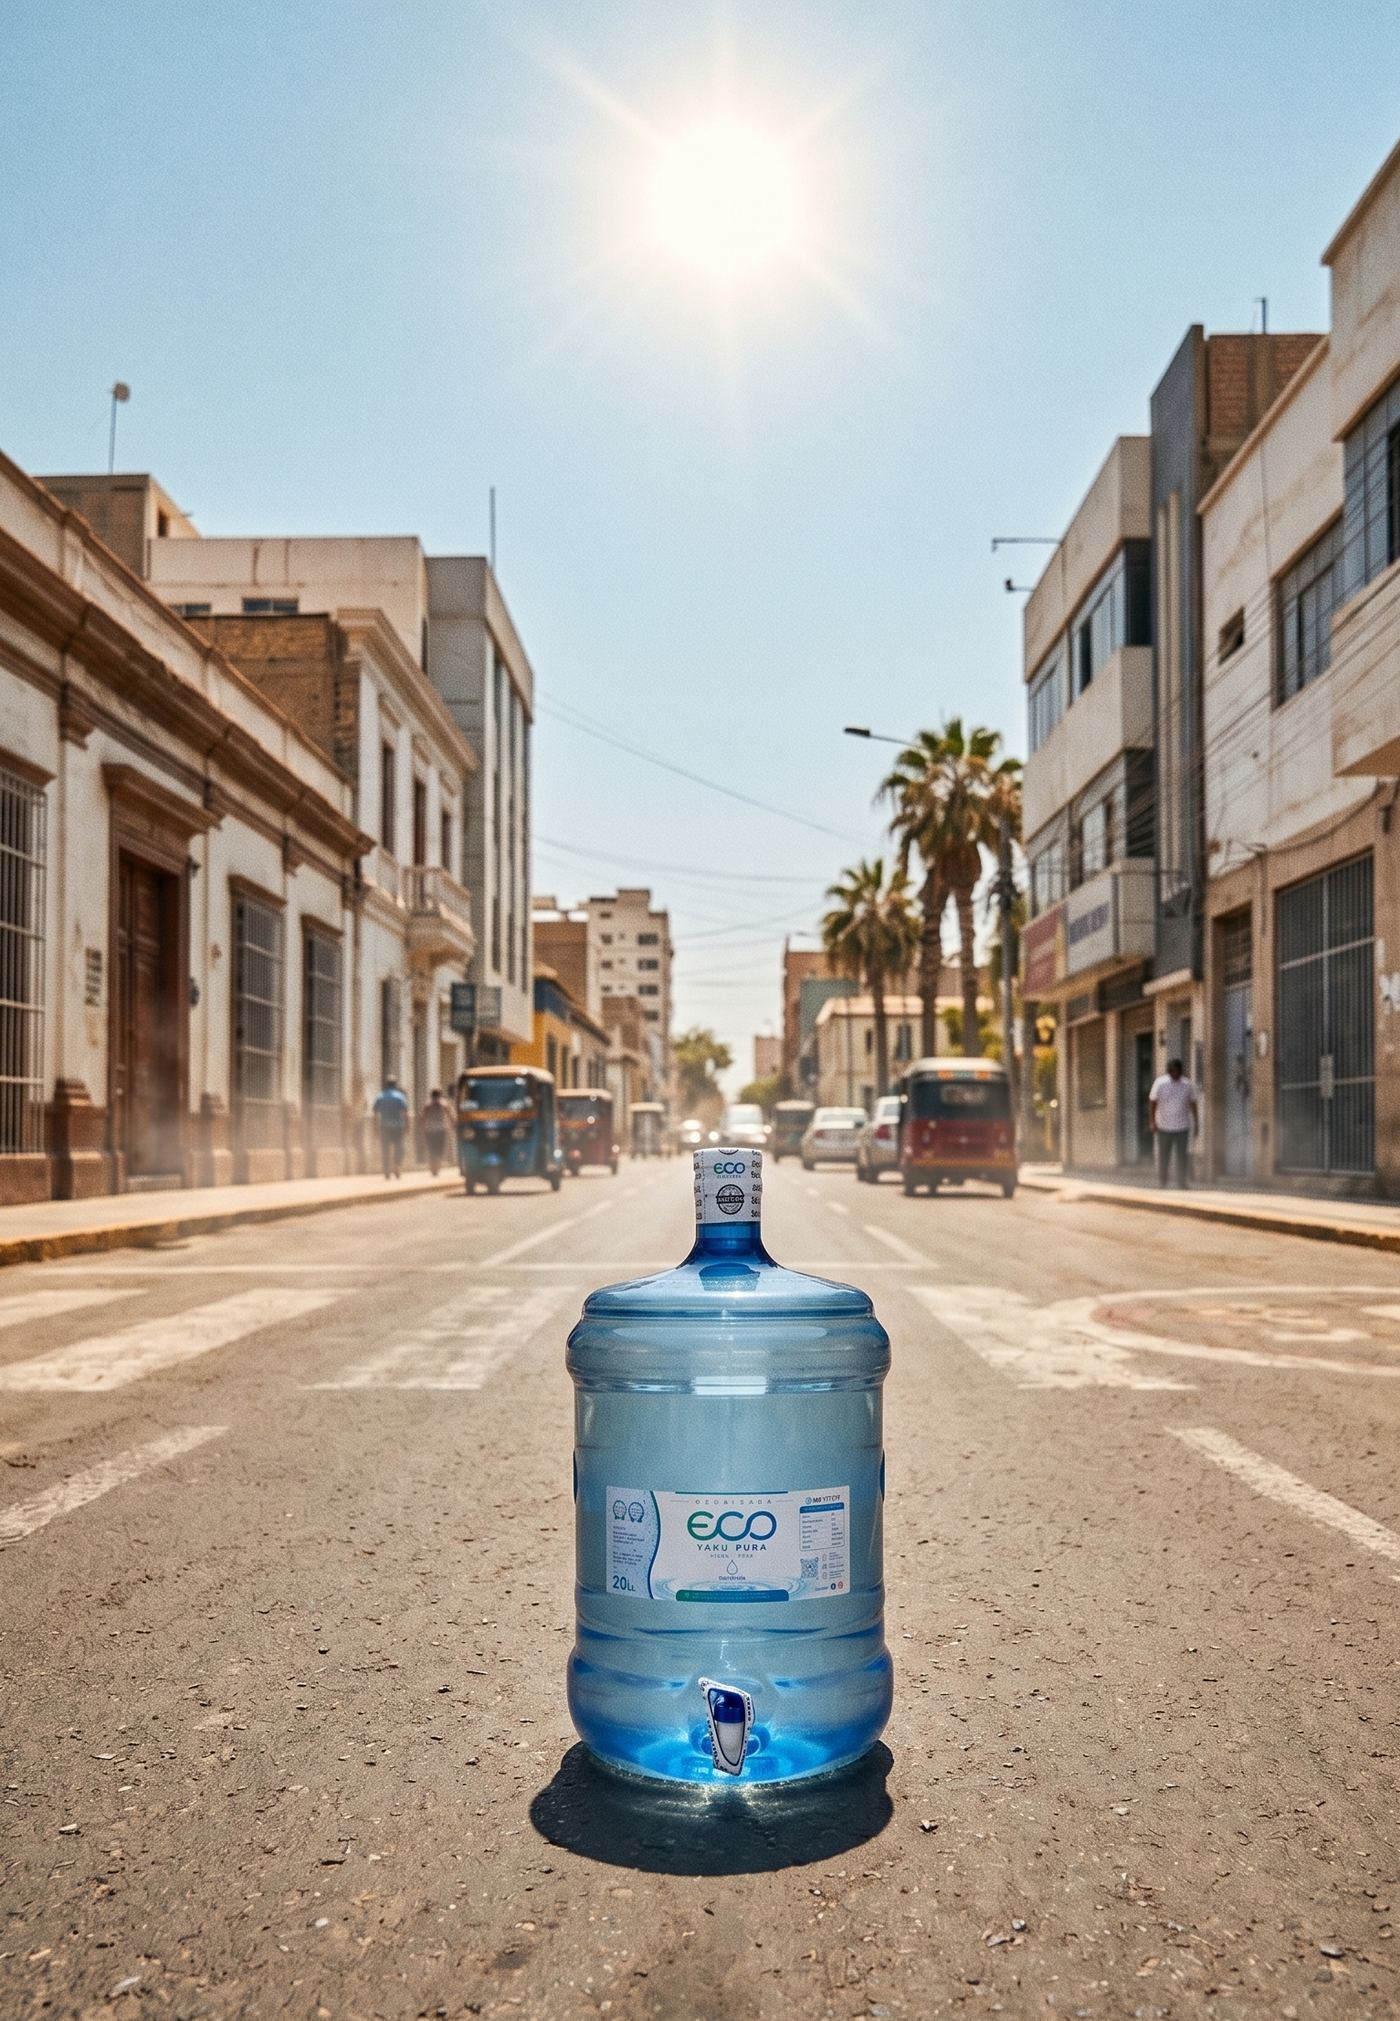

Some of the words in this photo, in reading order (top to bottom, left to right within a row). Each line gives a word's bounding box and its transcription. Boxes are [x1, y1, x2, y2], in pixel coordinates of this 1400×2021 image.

[686, 1510, 778, 1542] ECO
[697, 1543, 729, 1552] YAKU
[735, 1543, 767, 1552] PURA
